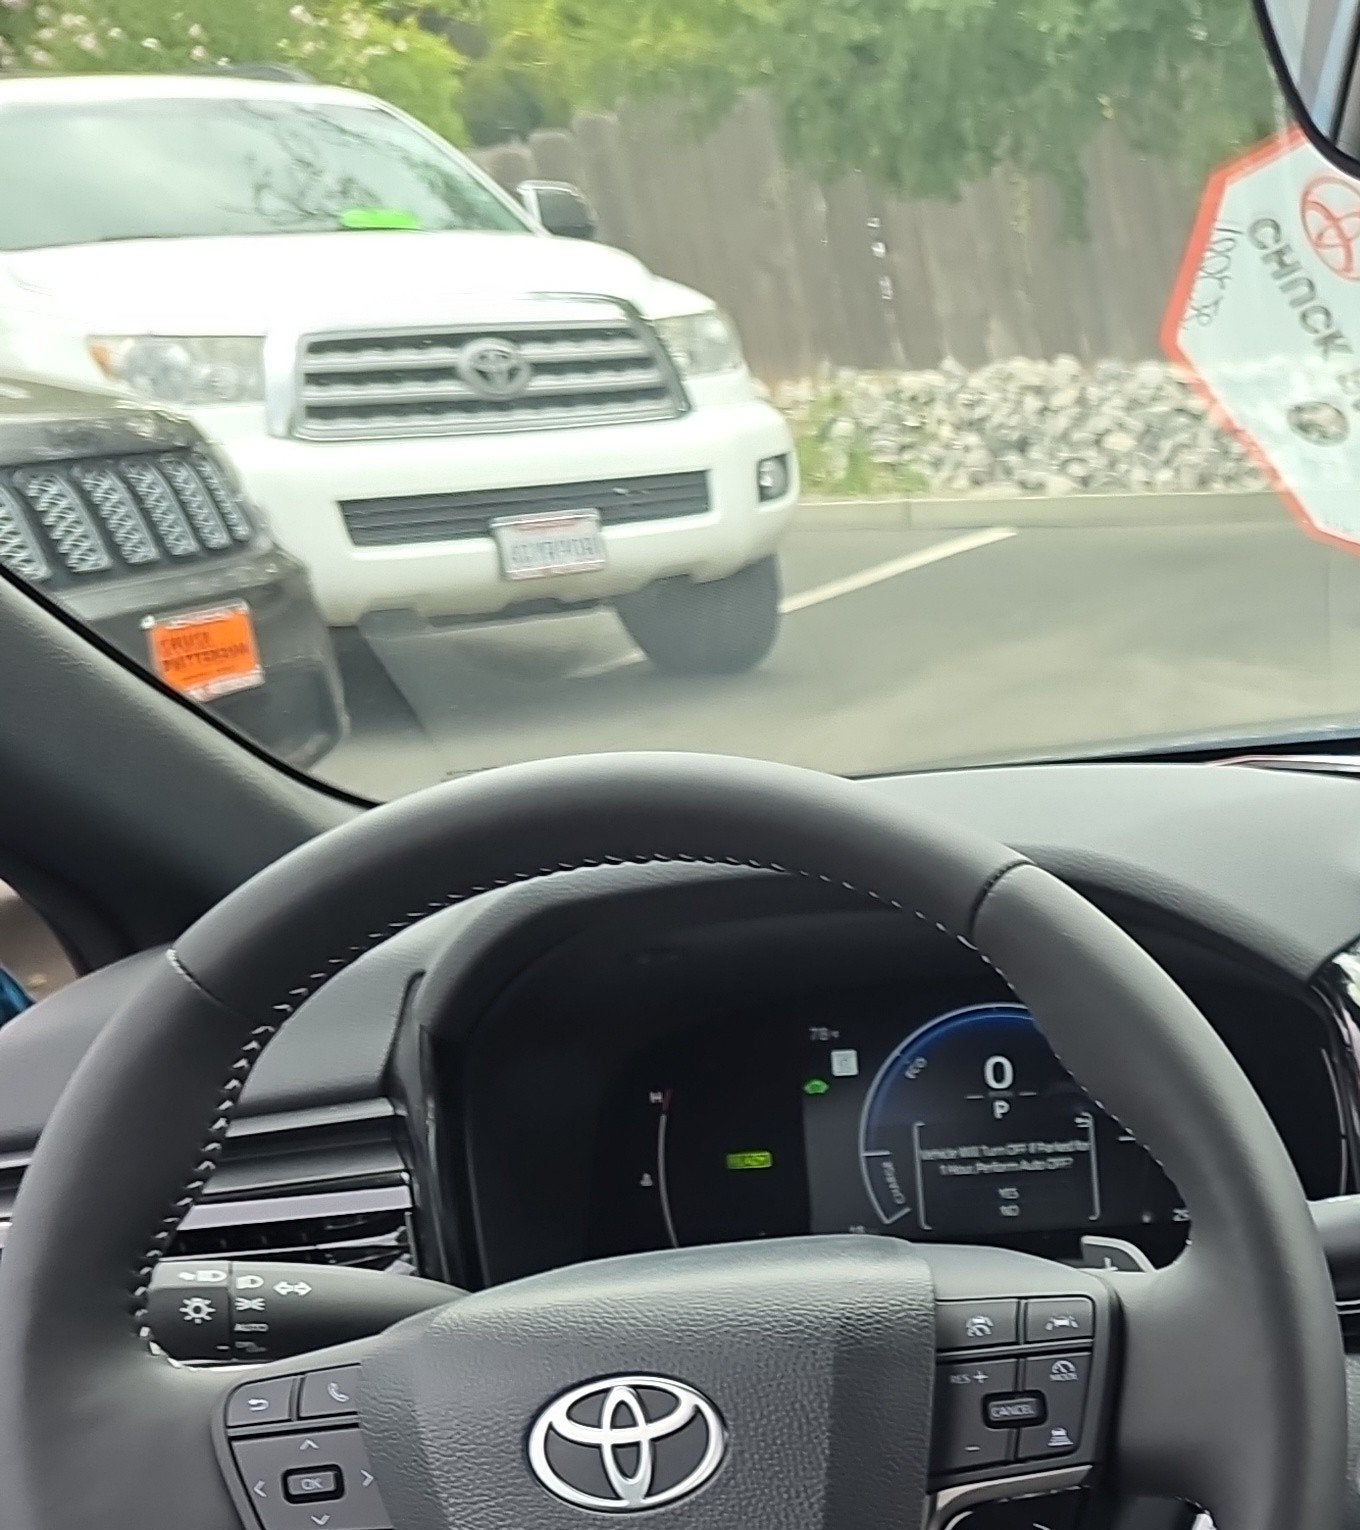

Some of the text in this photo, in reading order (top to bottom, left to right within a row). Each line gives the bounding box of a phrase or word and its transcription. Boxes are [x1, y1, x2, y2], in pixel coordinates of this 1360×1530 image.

[983, 1055, 1014, 1090] 0
[993, 1100, 1011, 1120] P
[989, 1404, 1036, 1419] CANCEL
[301, 1478, 323, 1490] OK
